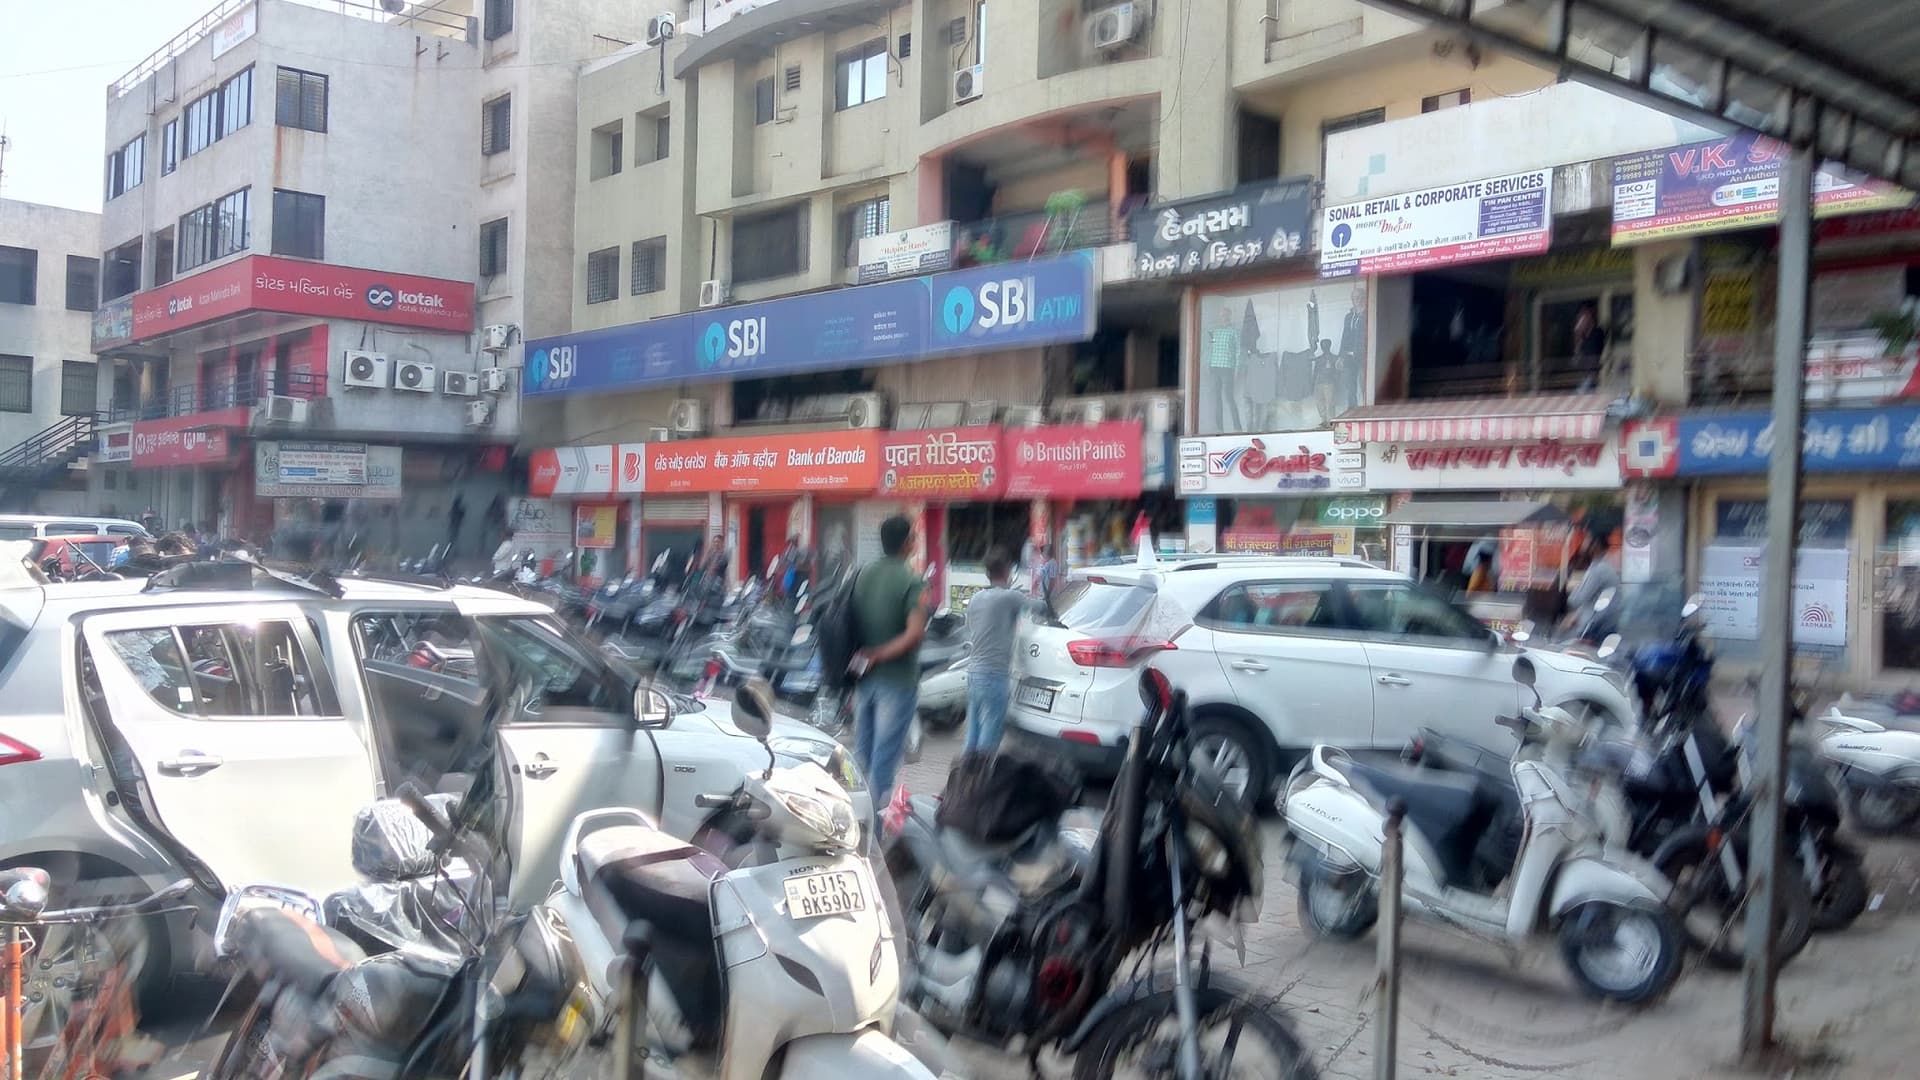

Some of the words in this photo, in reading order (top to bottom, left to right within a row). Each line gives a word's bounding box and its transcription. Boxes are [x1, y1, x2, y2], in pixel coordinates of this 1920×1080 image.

[1329, 206, 1362, 222] SONAL
[1365, 199, 1402, 215] RETAIL
[1403, 197, 1412, 209] &
[1415, 184, 1482, 207] CORPORATE
[1485, 173, 1545, 196] SERVICES
[1619, 185, 1643, 194] EKO
[256, 272, 286, 291] કોટક
[177, 296, 193, 312] kotak
[398, 290, 444, 308] kotak
[978, 276, 1036, 328] SBI
[1040, 294, 1081, 320] ATM
[727, 317, 767, 358] SBI
[549, 345, 577, 380] SBI
[787, 448, 813, 466] Bank
[815, 447, 827, 464] of
[827, 445, 866, 466] Baroda
[885, 443, 922, 467] पवन
[926, 432, 997, 466] मेडिकल
[1037, 442, 1081, 462] British
[1083, 440, 1126, 461] Paints
[1337, 477, 1360, 486] vivo
[1327, 506, 1384, 519] oppo
[807, 874, 847, 895] GJ15
